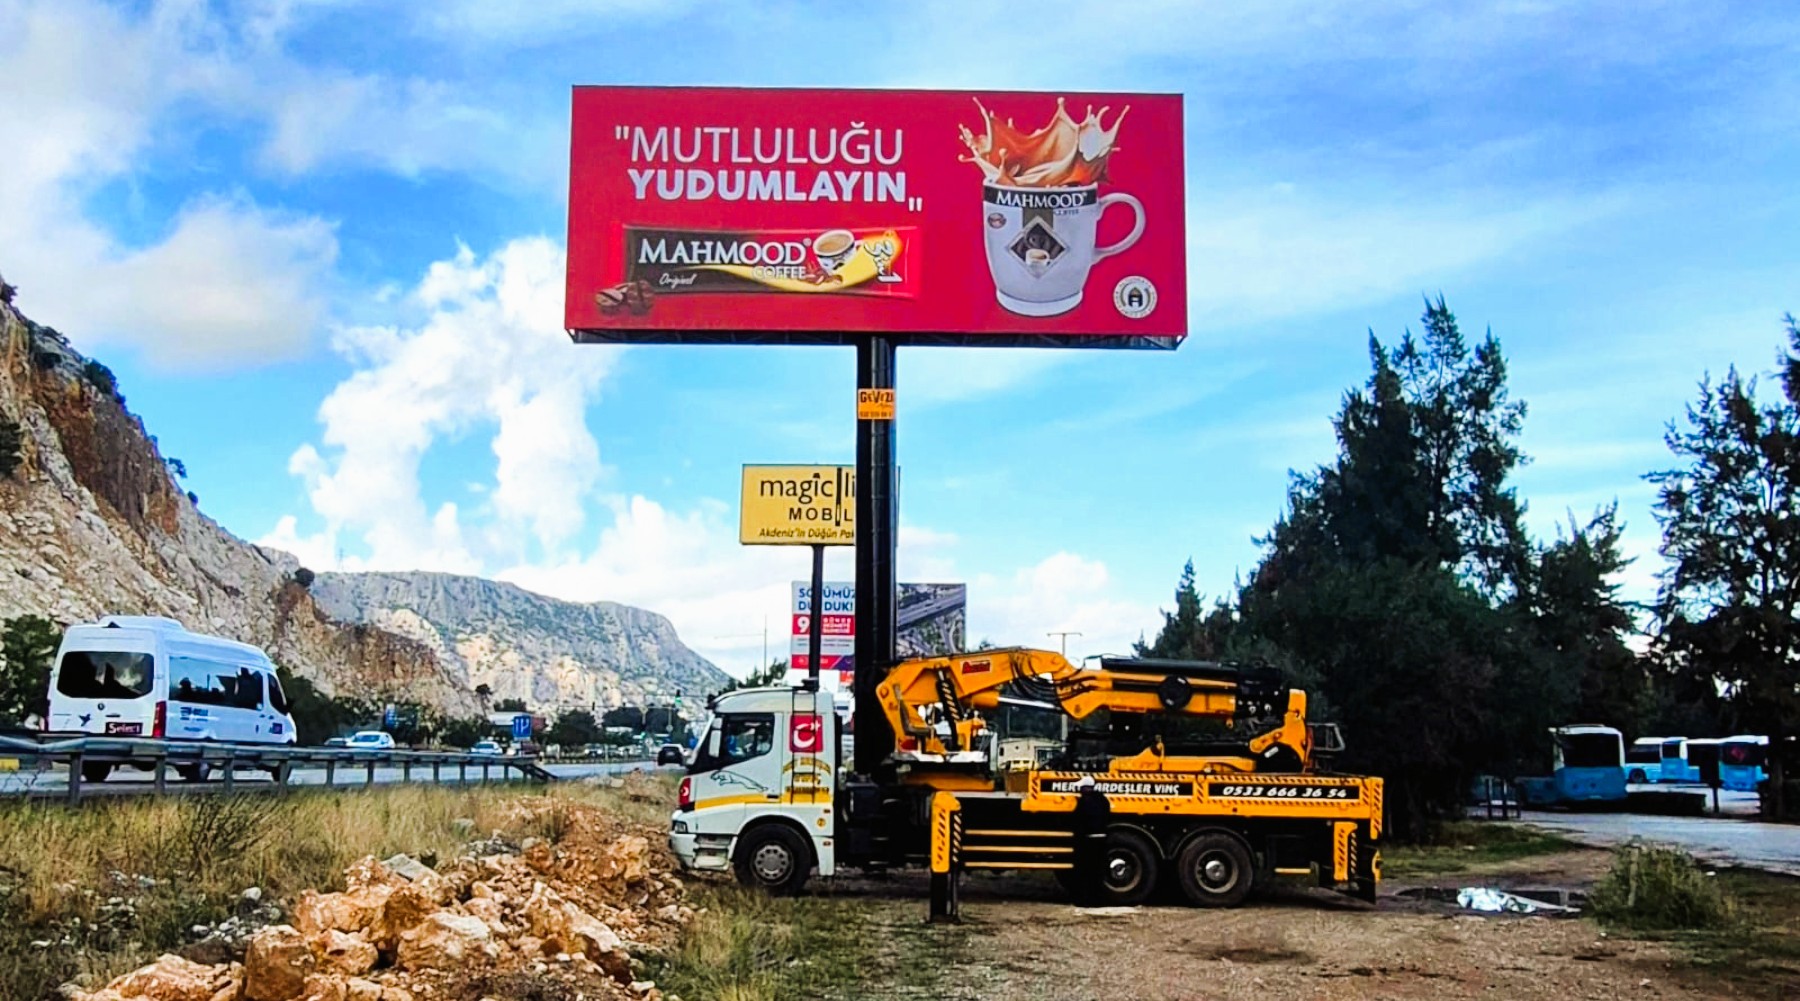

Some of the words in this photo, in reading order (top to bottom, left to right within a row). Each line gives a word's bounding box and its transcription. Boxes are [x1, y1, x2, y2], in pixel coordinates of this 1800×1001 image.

[615, 121, 903, 164] "MUTLULUĞU
[752, 266, 806, 280] COFFEE
[659, 273, 697, 289] Original
[760, 473, 834, 504] magic
[1093, 782, 1152, 794] ARDEŞLER
[1222, 786, 1264, 796] 0533
[1267, 787, 1298, 797] 666
[1302, 787, 1323, 797] 36
[1327, 788, 1347, 798] 54
